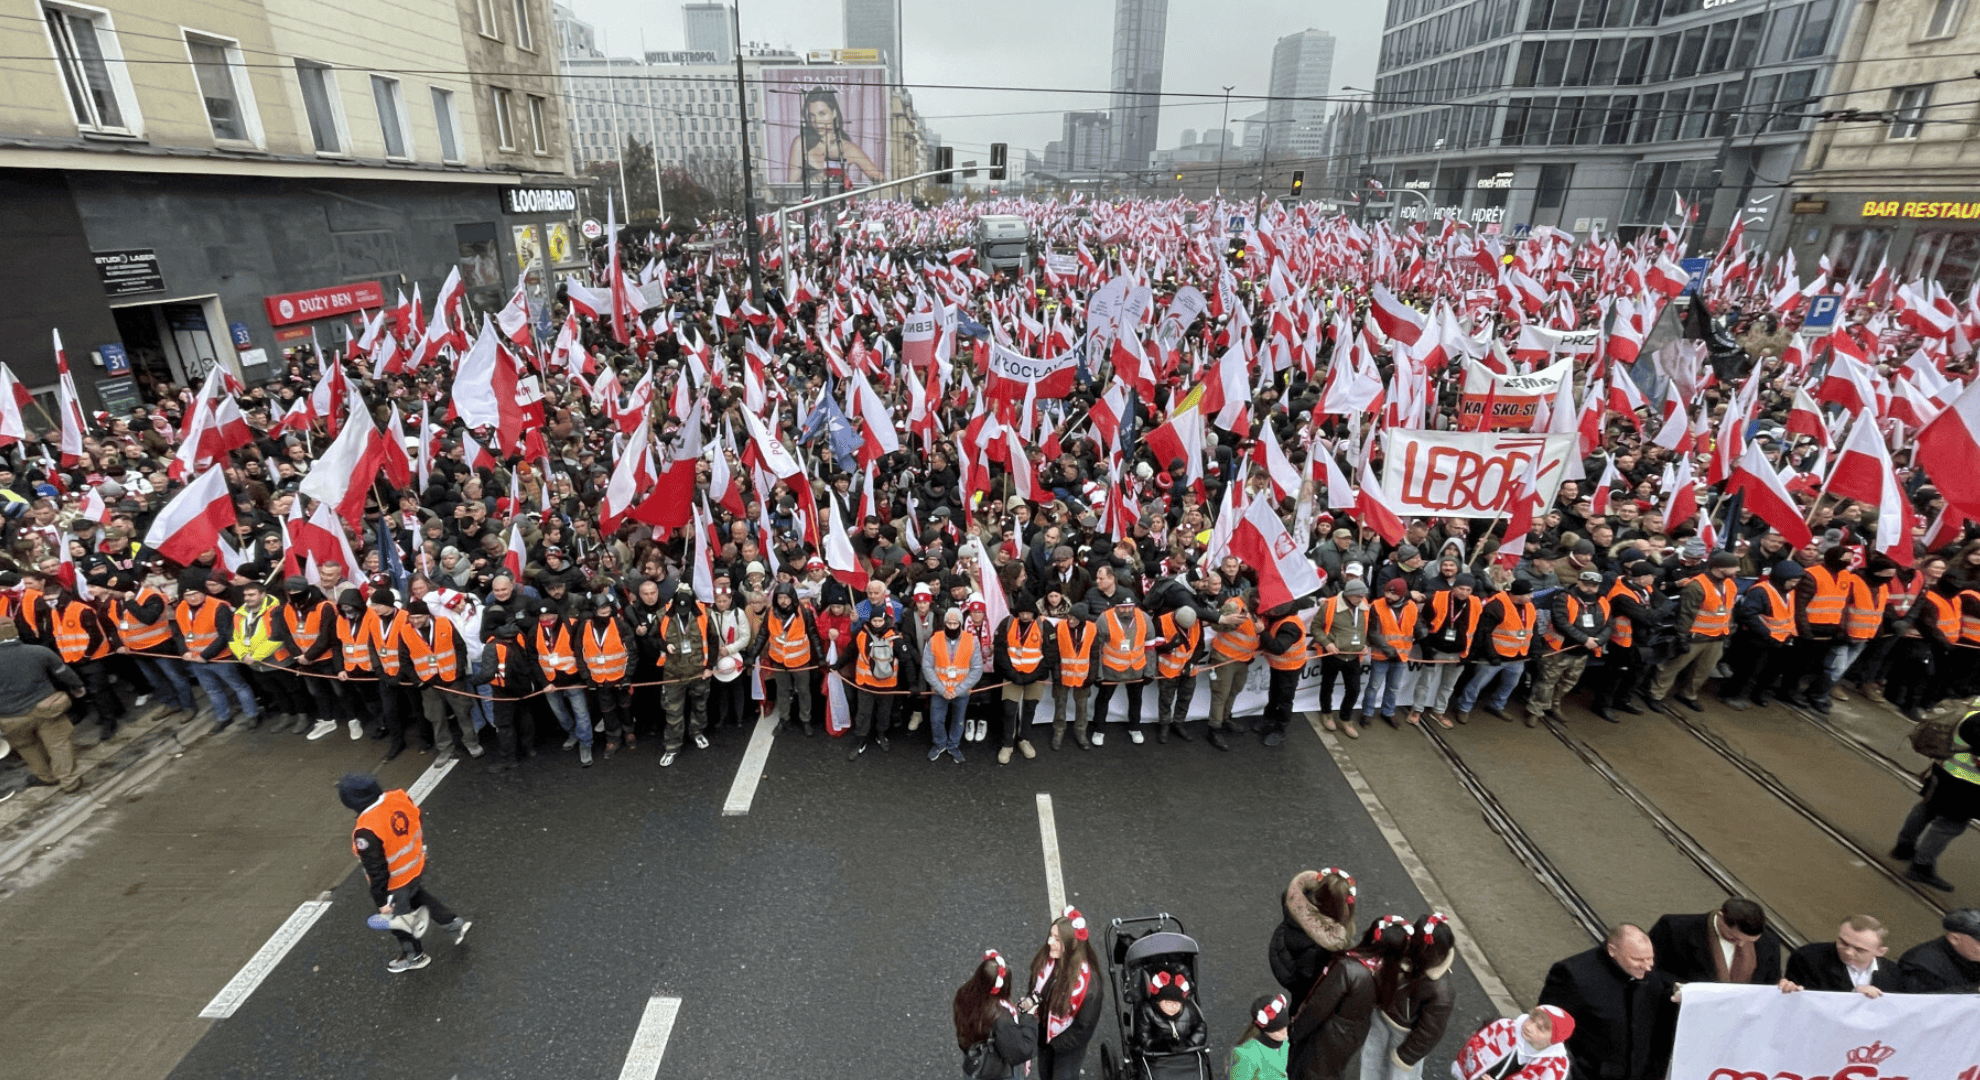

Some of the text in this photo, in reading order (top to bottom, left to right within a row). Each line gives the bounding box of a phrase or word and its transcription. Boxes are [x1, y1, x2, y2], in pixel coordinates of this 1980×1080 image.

[645, 51, 717, 64] HOTEL METROPOL
[511, 189, 576, 213] LOOMBARD
[1861, 201, 1900, 217] BAR
[298, 295, 329, 313] DUŻY
[331, 292, 353, 308] BEN
[1813, 297, 1835, 317] P
[236, 331, 250, 344] 33
[109, 354, 126, 370] 31
